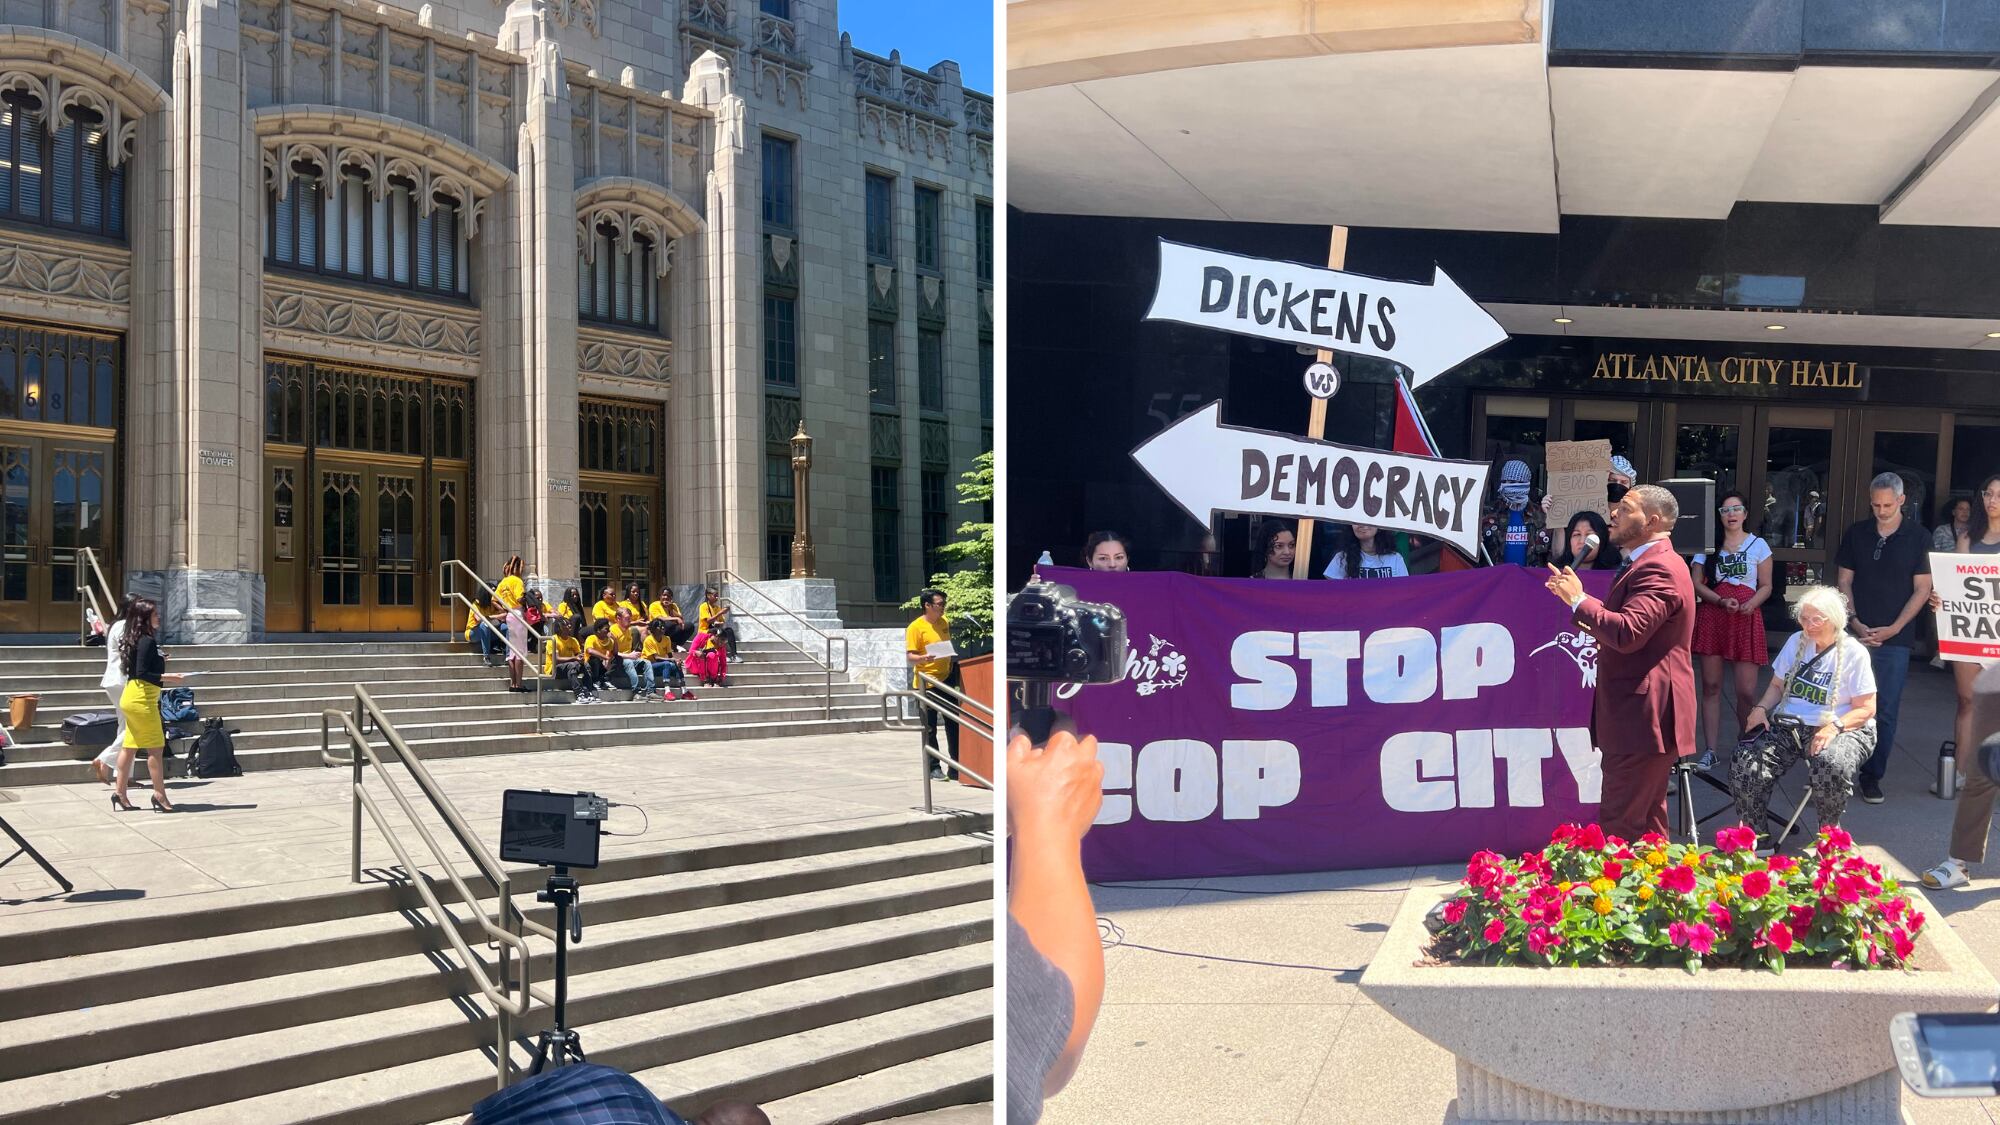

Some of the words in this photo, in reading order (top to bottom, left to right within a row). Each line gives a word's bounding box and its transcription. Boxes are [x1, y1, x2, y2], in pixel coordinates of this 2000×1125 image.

[1200, 266, 1396, 351] DICKENS
[1310, 372, 1334, 393] VS
[1592, 353, 1712, 383] ATLANTA
[1720, 357, 1784, 385] CITY
[1791, 361, 1862, 389] HALL
[201, 457, 234, 467] TOWER
[217, 451, 234, 459] HALL
[1241, 449, 1476, 532] DEMOCRACY
[1559, 474, 1598, 491] END
[1956, 565, 1999, 575] MAYOR
[1231, 622, 1515, 711] STOP
[1380, 727, 1603, 813] CITY
